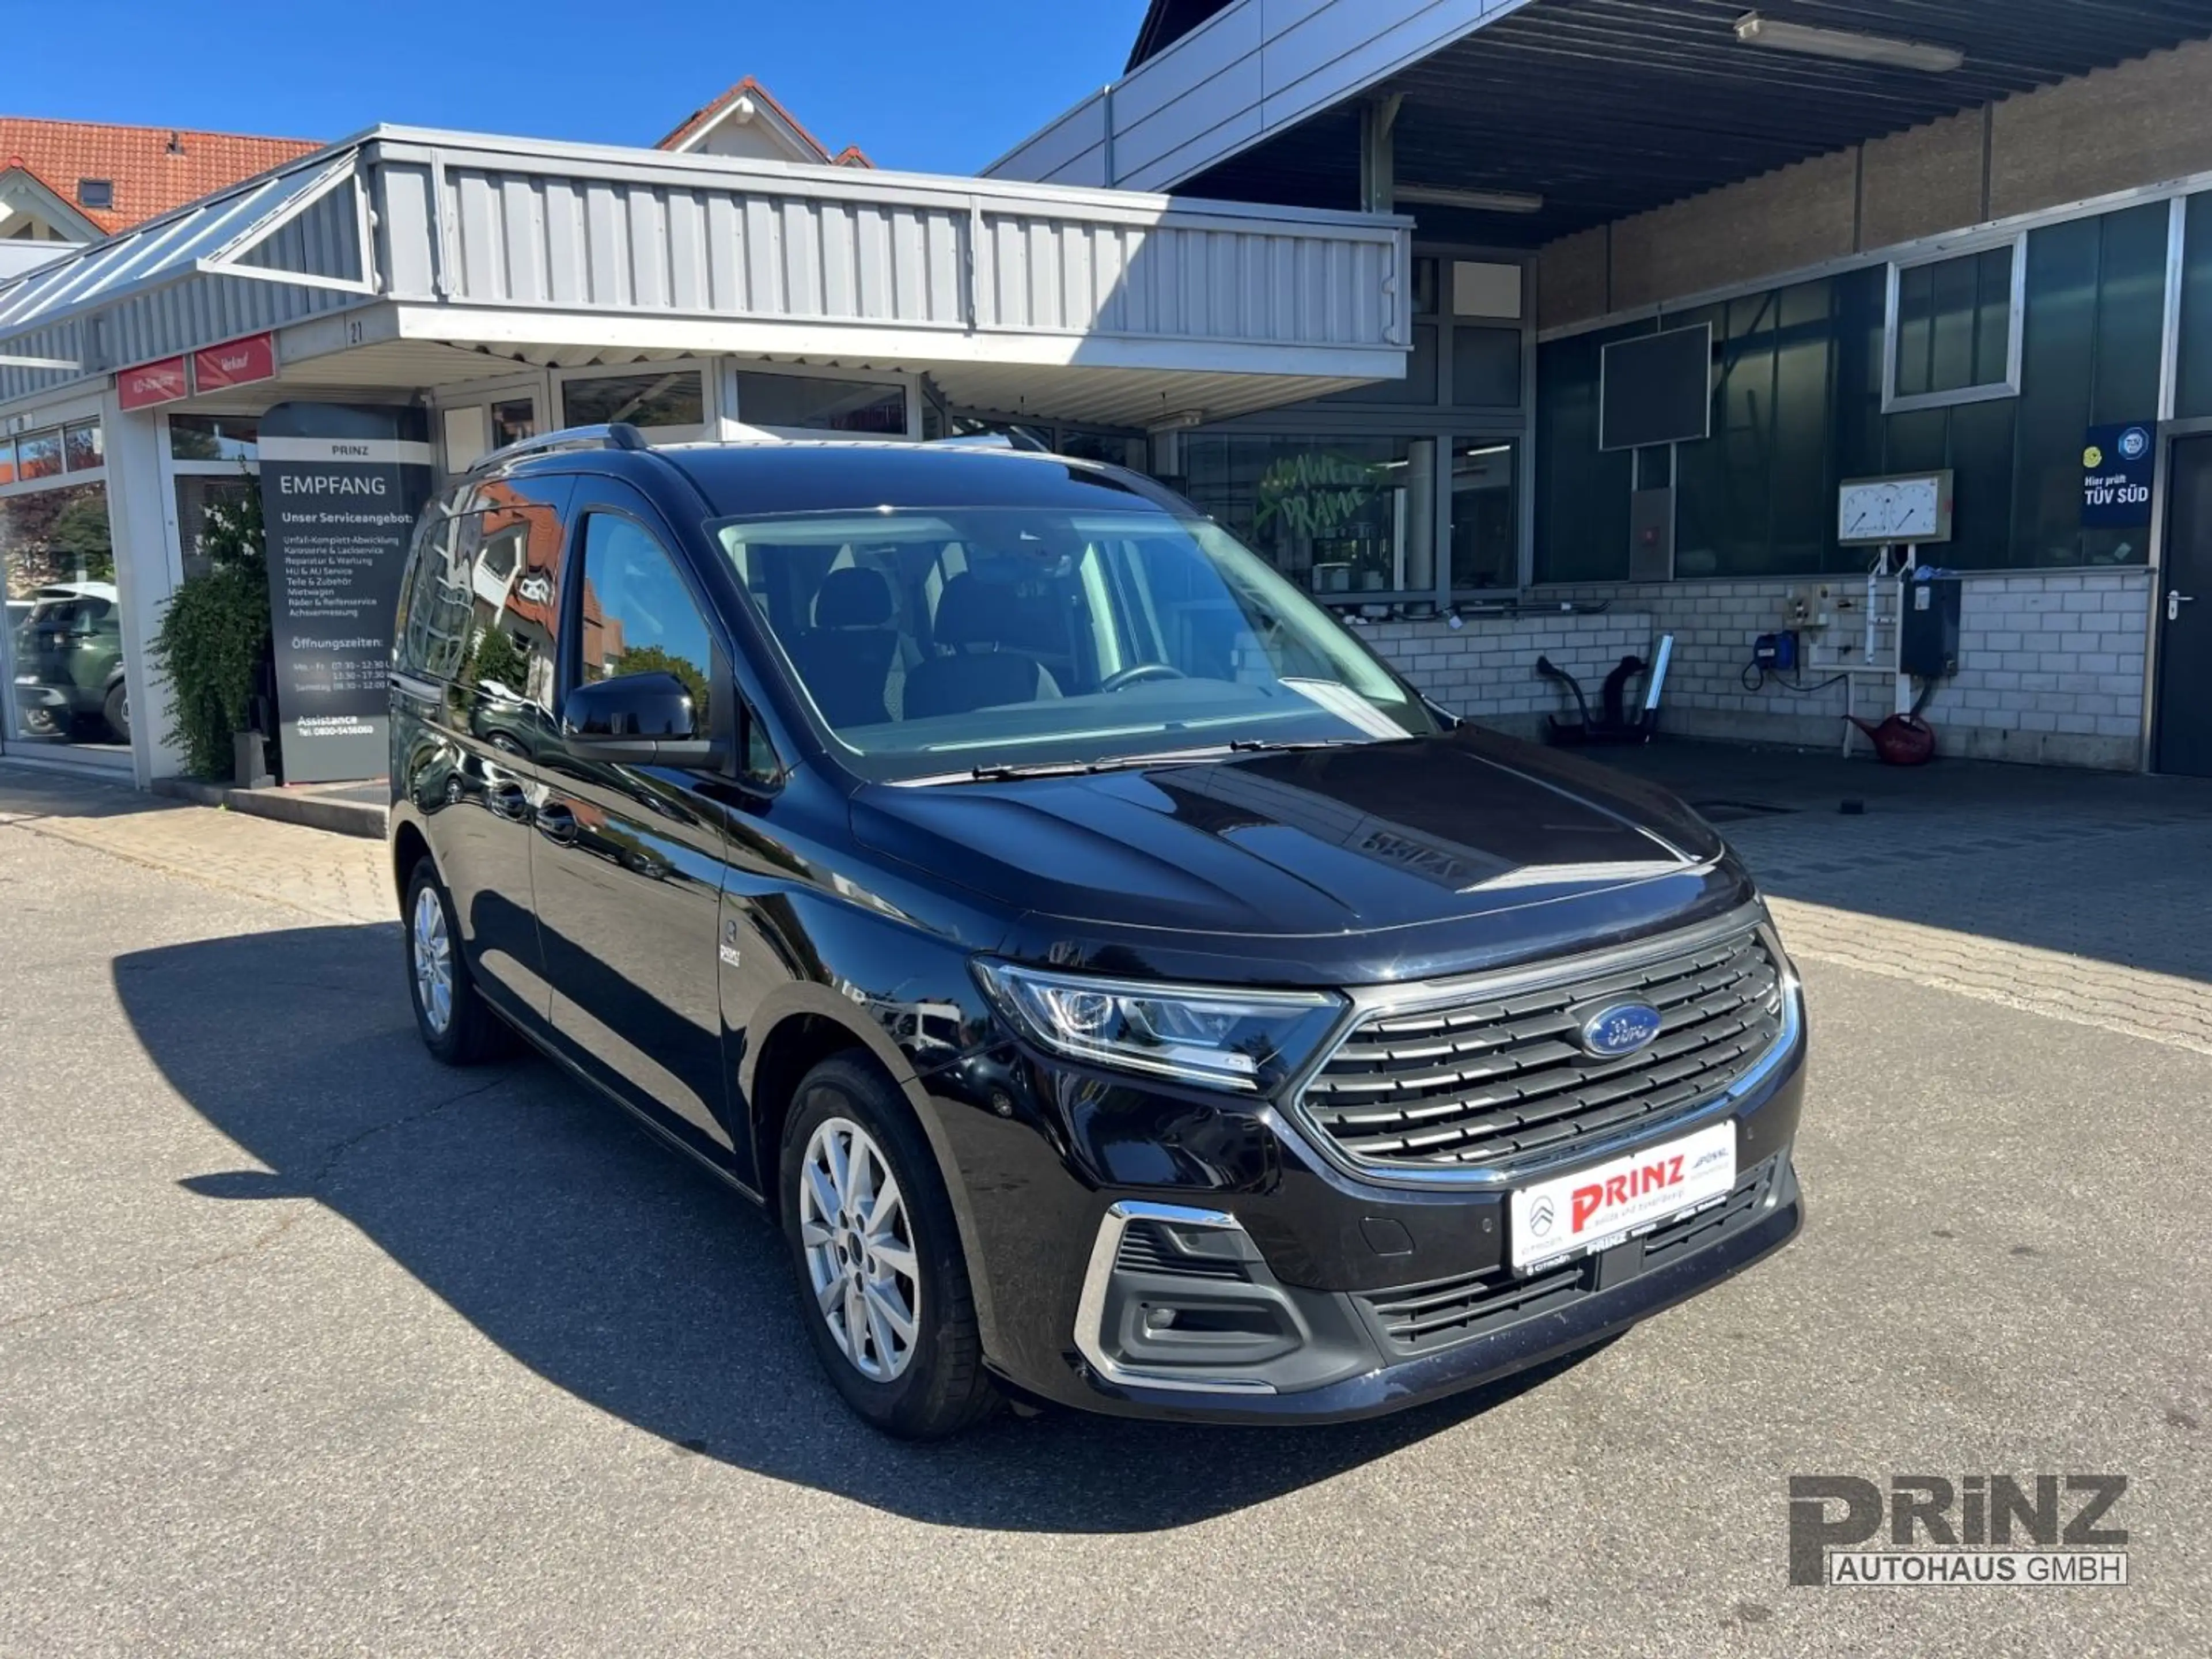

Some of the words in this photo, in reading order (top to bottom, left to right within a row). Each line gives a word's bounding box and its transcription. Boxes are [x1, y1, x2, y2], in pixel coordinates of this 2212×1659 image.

[350, 320, 362, 344] 21
[331, 445, 369, 456] PRINZ
[280, 475, 386, 495] EMPFANG
[2084, 476, 2104, 487] Hier
[2105, 473, 2127, 487] prüft
[2084, 487, 2114, 505] TÜV
[2117, 483, 2149, 503] SÜD
[282, 512, 317, 523] Unser
[319, 512, 414, 527] Serviceangebot:
[287, 578, 306, 586] Teile
[291, 636, 384, 650] Öffnungszeiten:
[1571, 1154, 1685, 1234] PRINZ
